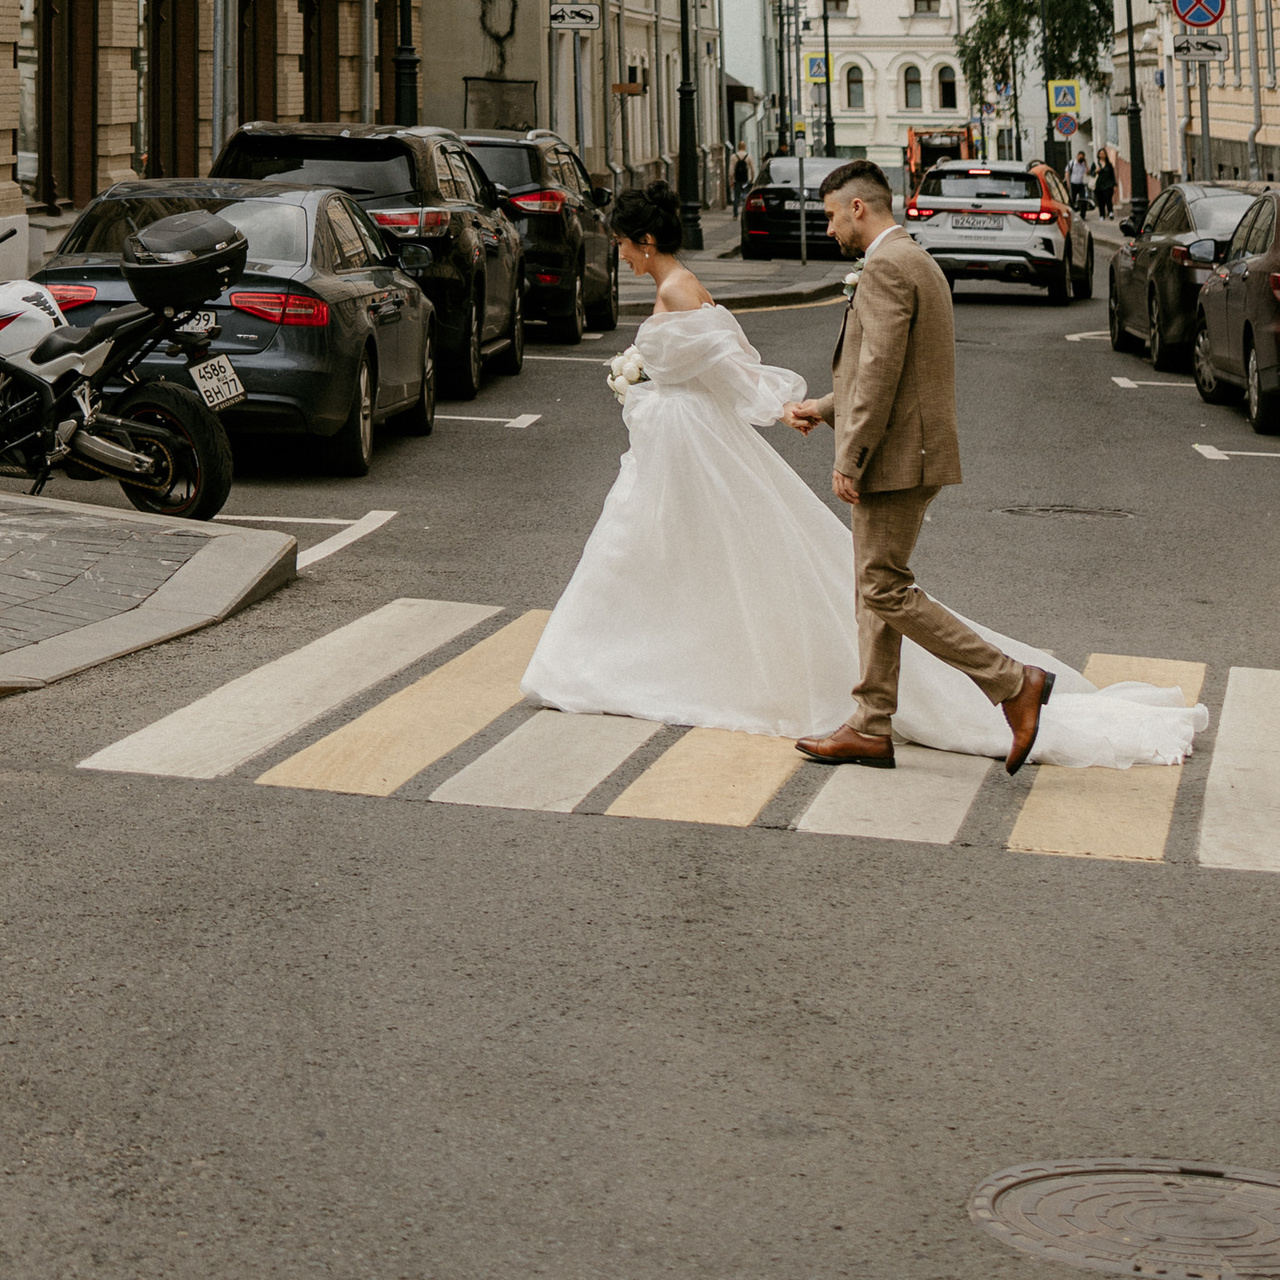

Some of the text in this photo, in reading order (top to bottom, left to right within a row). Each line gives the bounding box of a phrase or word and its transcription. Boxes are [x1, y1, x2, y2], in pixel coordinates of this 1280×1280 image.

[198, 360, 227, 382] 4586
[222, 378, 239, 396] 77
[219, 394, 245, 410] HONDA
